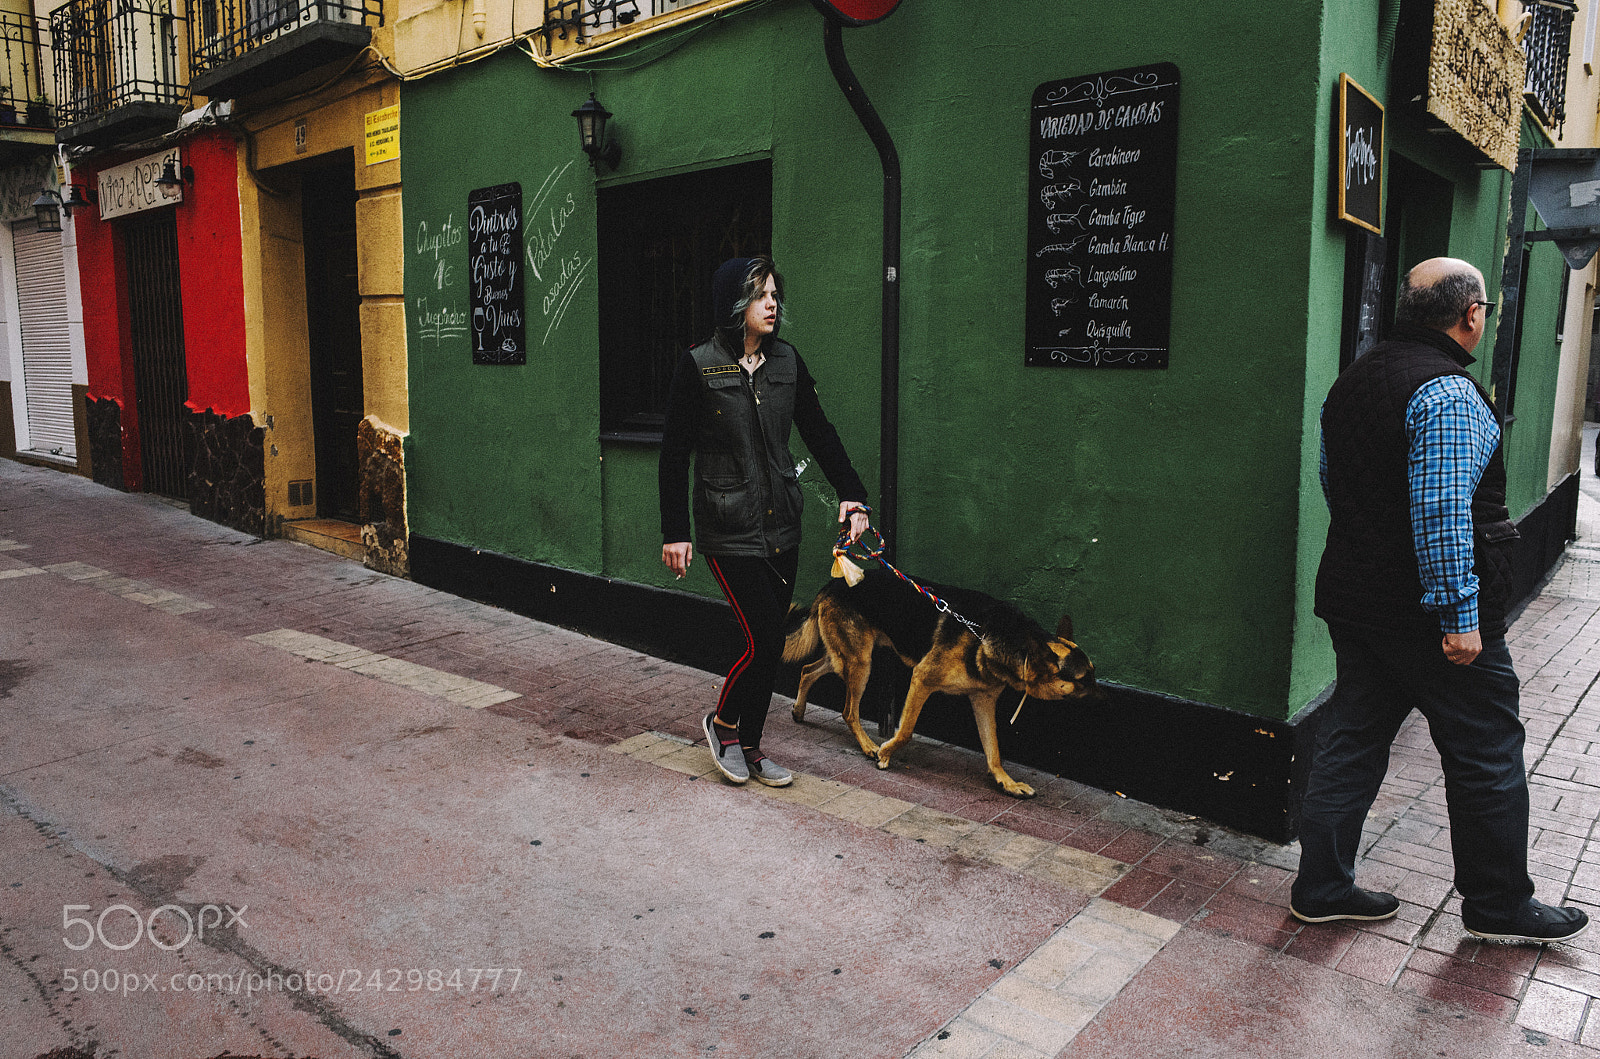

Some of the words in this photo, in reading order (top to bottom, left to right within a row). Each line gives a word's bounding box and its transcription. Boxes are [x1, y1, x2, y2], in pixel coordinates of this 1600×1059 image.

[366, 115, 373, 126] El
[1040, 112, 1094, 139] VARIEDAD
[1095, 107, 1115, 131] DE
[296, 126, 306, 146] 49
[1088, 145, 1141, 168] Carabinero
[1089, 177, 1127, 197] Gambón
[1088, 207, 1121, 226] Gamba
[1122, 204, 1146, 229] Tigre
[416, 213, 463, 261] Chupitos
[488, 235, 498, 252] tu
[525, 192, 576, 282] Patatas
[1088, 235, 1120, 255] Gamba
[1121, 234, 1156, 254] Blanca
[508, 260, 517, 291] y
[543, 251, 581, 315] asadas
[1087, 264, 1137, 288] Langostino
[485, 303, 521, 337] Vinos
[1086, 319, 1132, 344] Quisquilla
